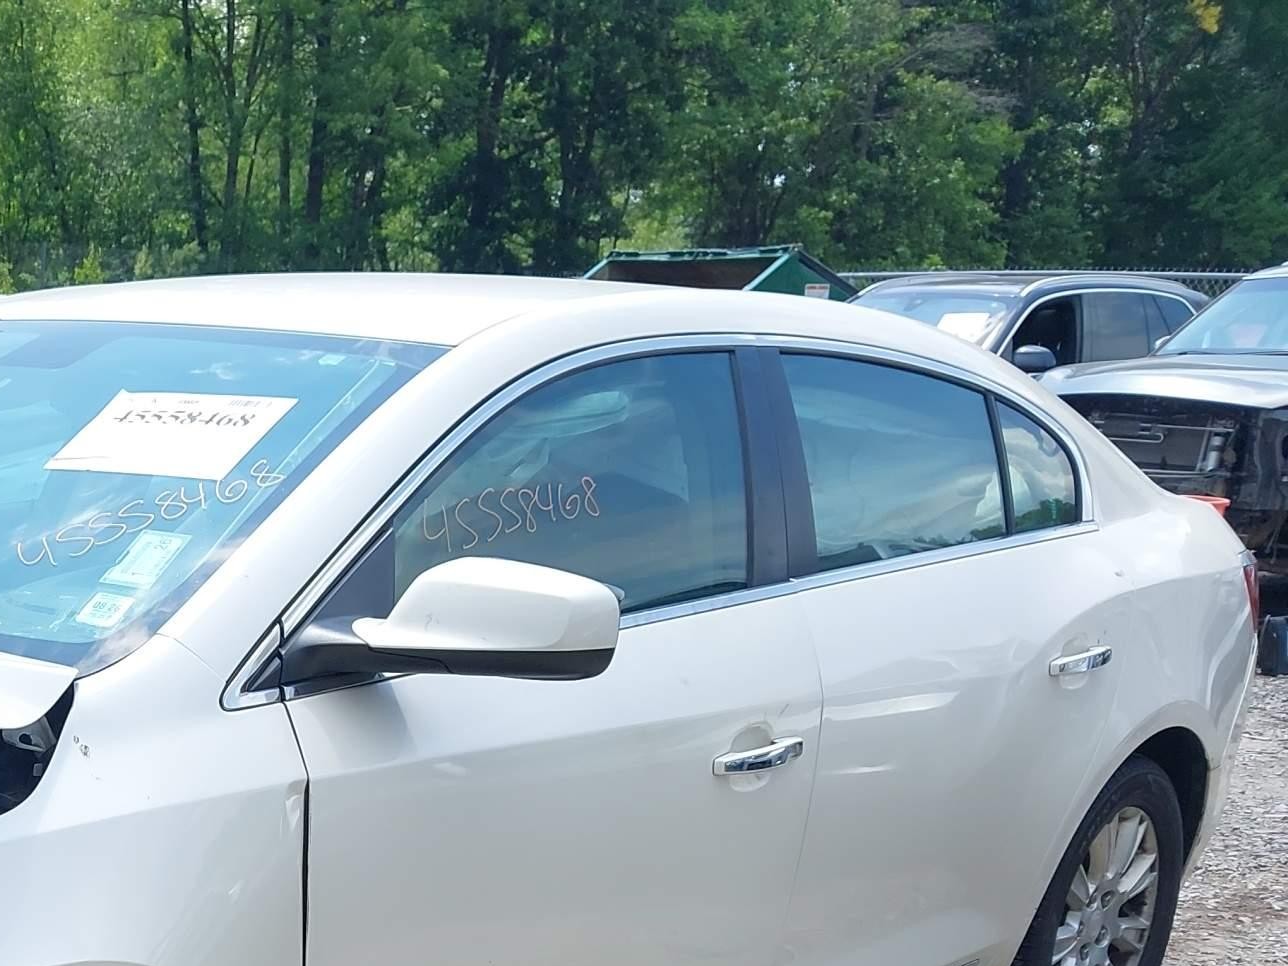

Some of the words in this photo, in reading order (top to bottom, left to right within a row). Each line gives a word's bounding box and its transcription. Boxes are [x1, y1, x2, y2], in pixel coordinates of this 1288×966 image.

[112, 409, 257, 428] 45558468
[17, 459, 285, 567] 45558468
[423, 476, 600, 553] 45558468
